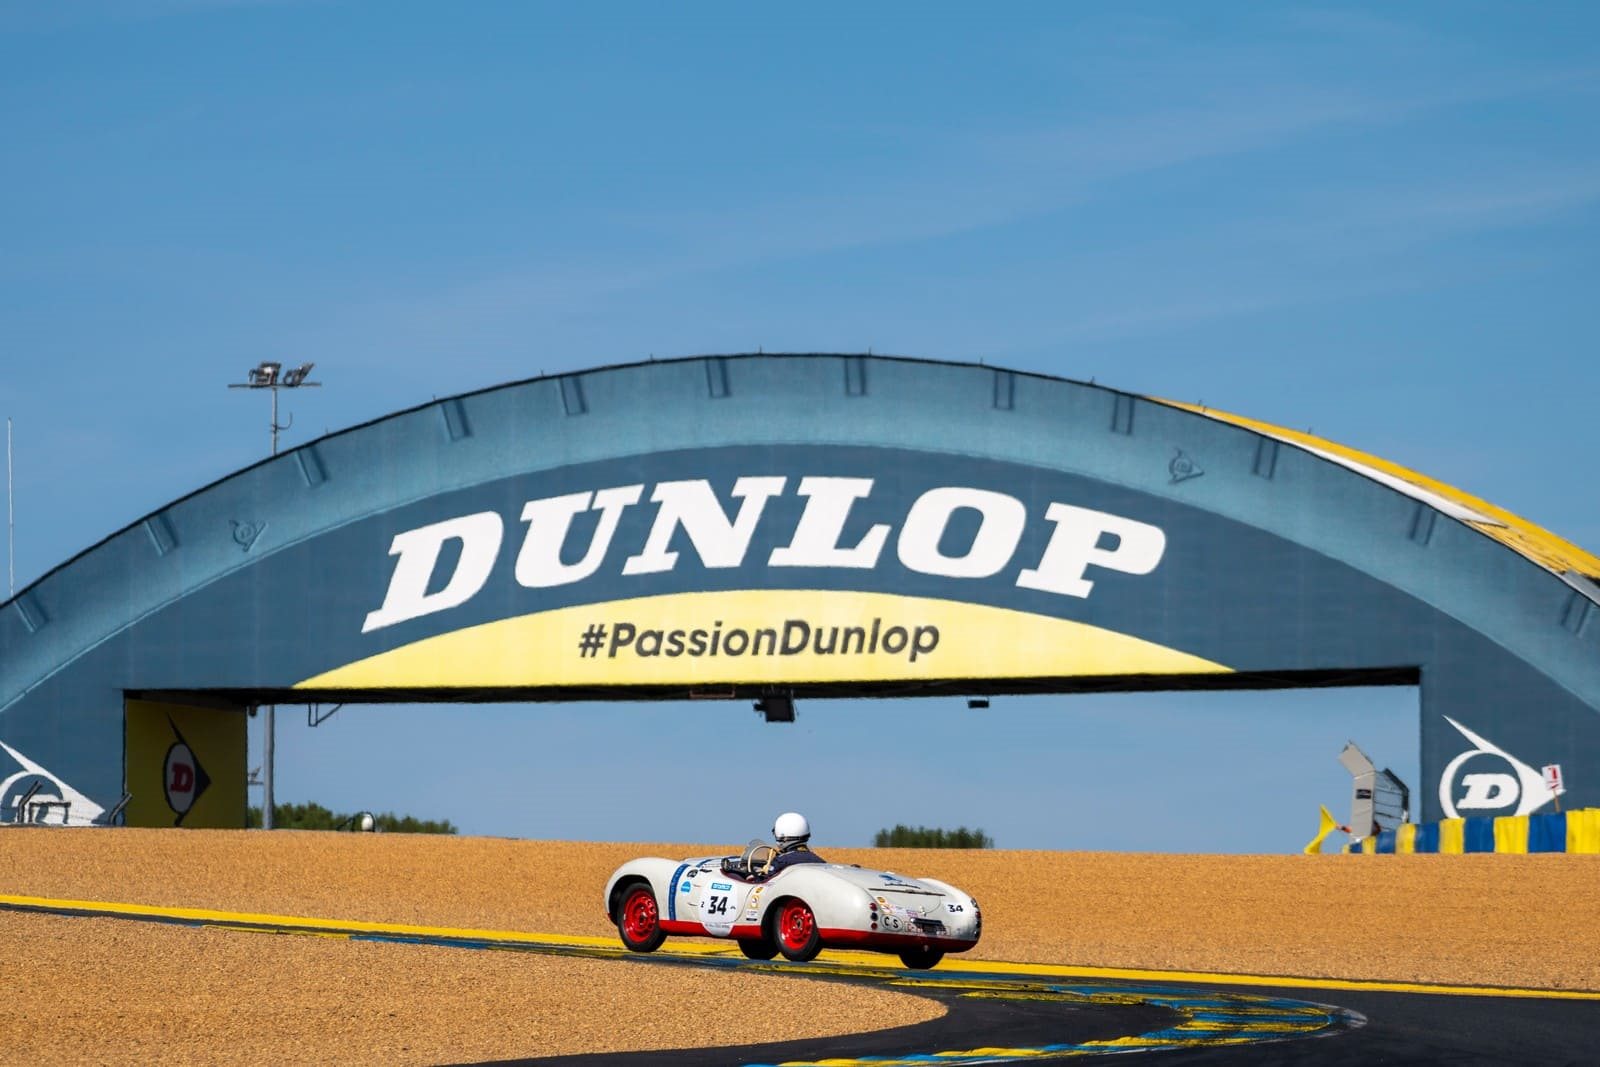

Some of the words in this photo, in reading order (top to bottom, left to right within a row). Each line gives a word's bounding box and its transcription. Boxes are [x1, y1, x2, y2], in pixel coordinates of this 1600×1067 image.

[362, 476, 1167, 633] DUNLOP
[578, 616, 940, 662] #PassionDunlop
[170, 763, 193, 791] D
[1456, 773, 1519, 809] D
[708, 896, 728, 915] 34
[948, 904, 963, 913] 34
